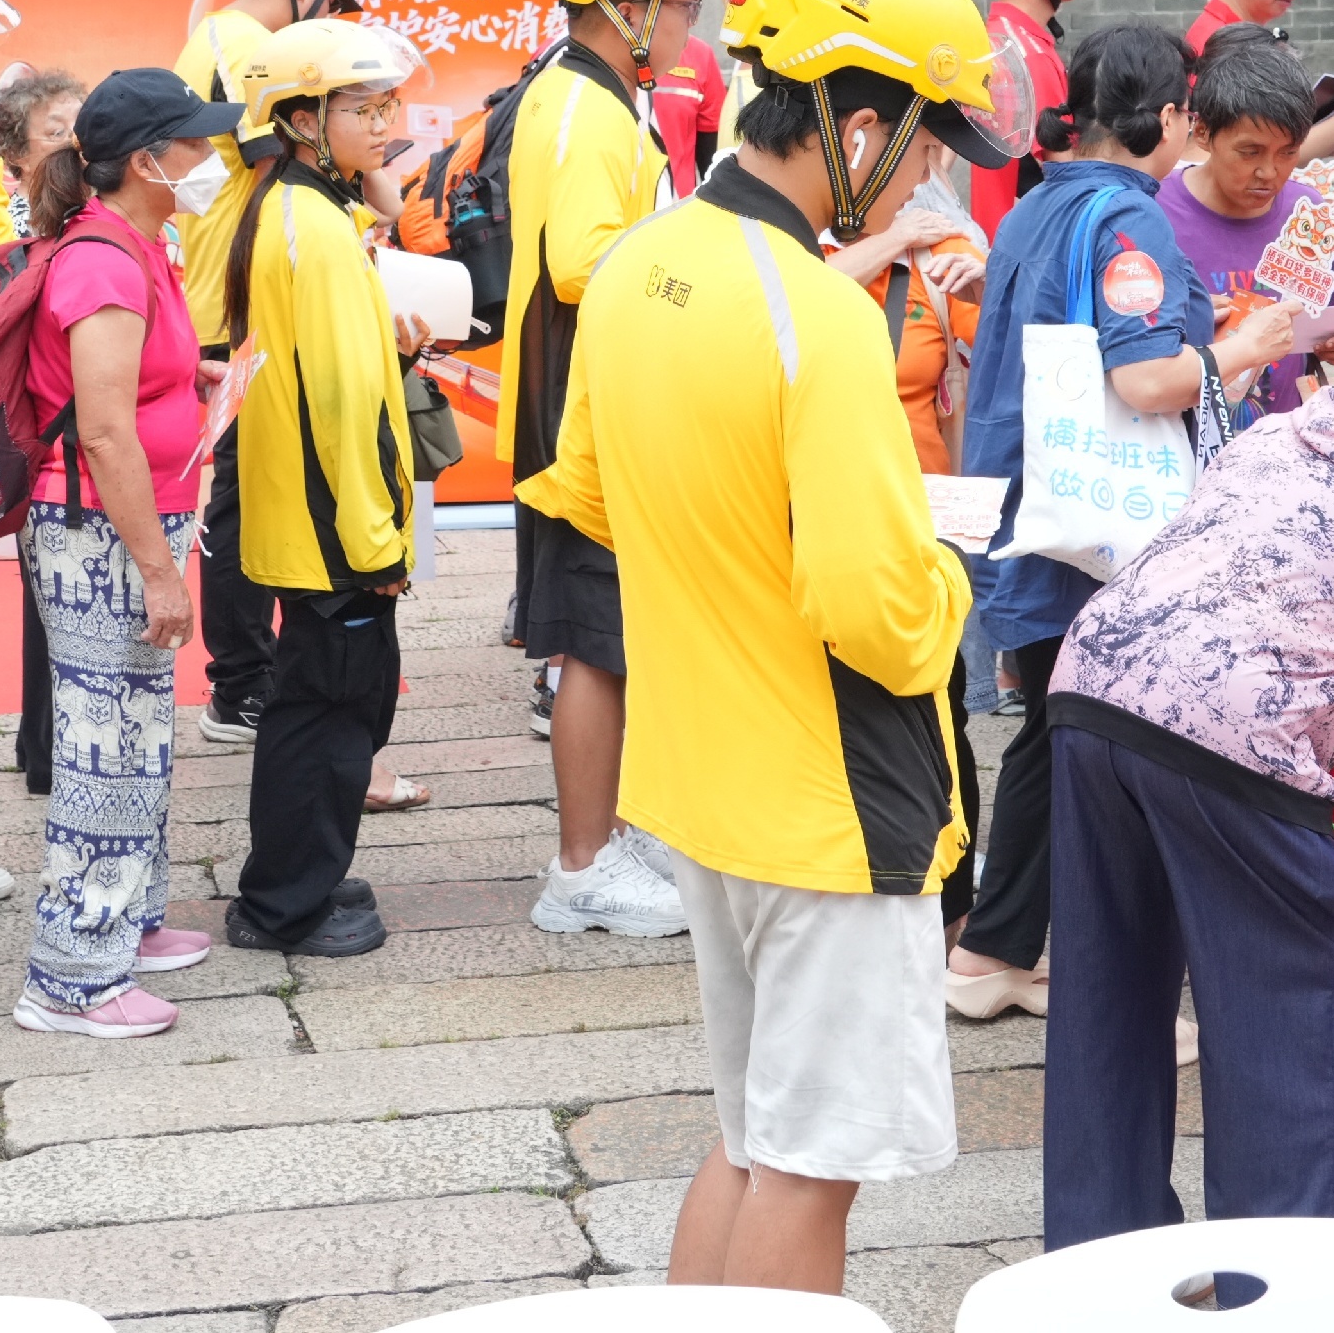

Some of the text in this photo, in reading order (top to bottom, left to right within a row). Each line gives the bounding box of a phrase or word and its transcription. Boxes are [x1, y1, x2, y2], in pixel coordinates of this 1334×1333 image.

[660, 277, 693, 308] 美团
[1043, 417, 1180, 477] 横扫班味
